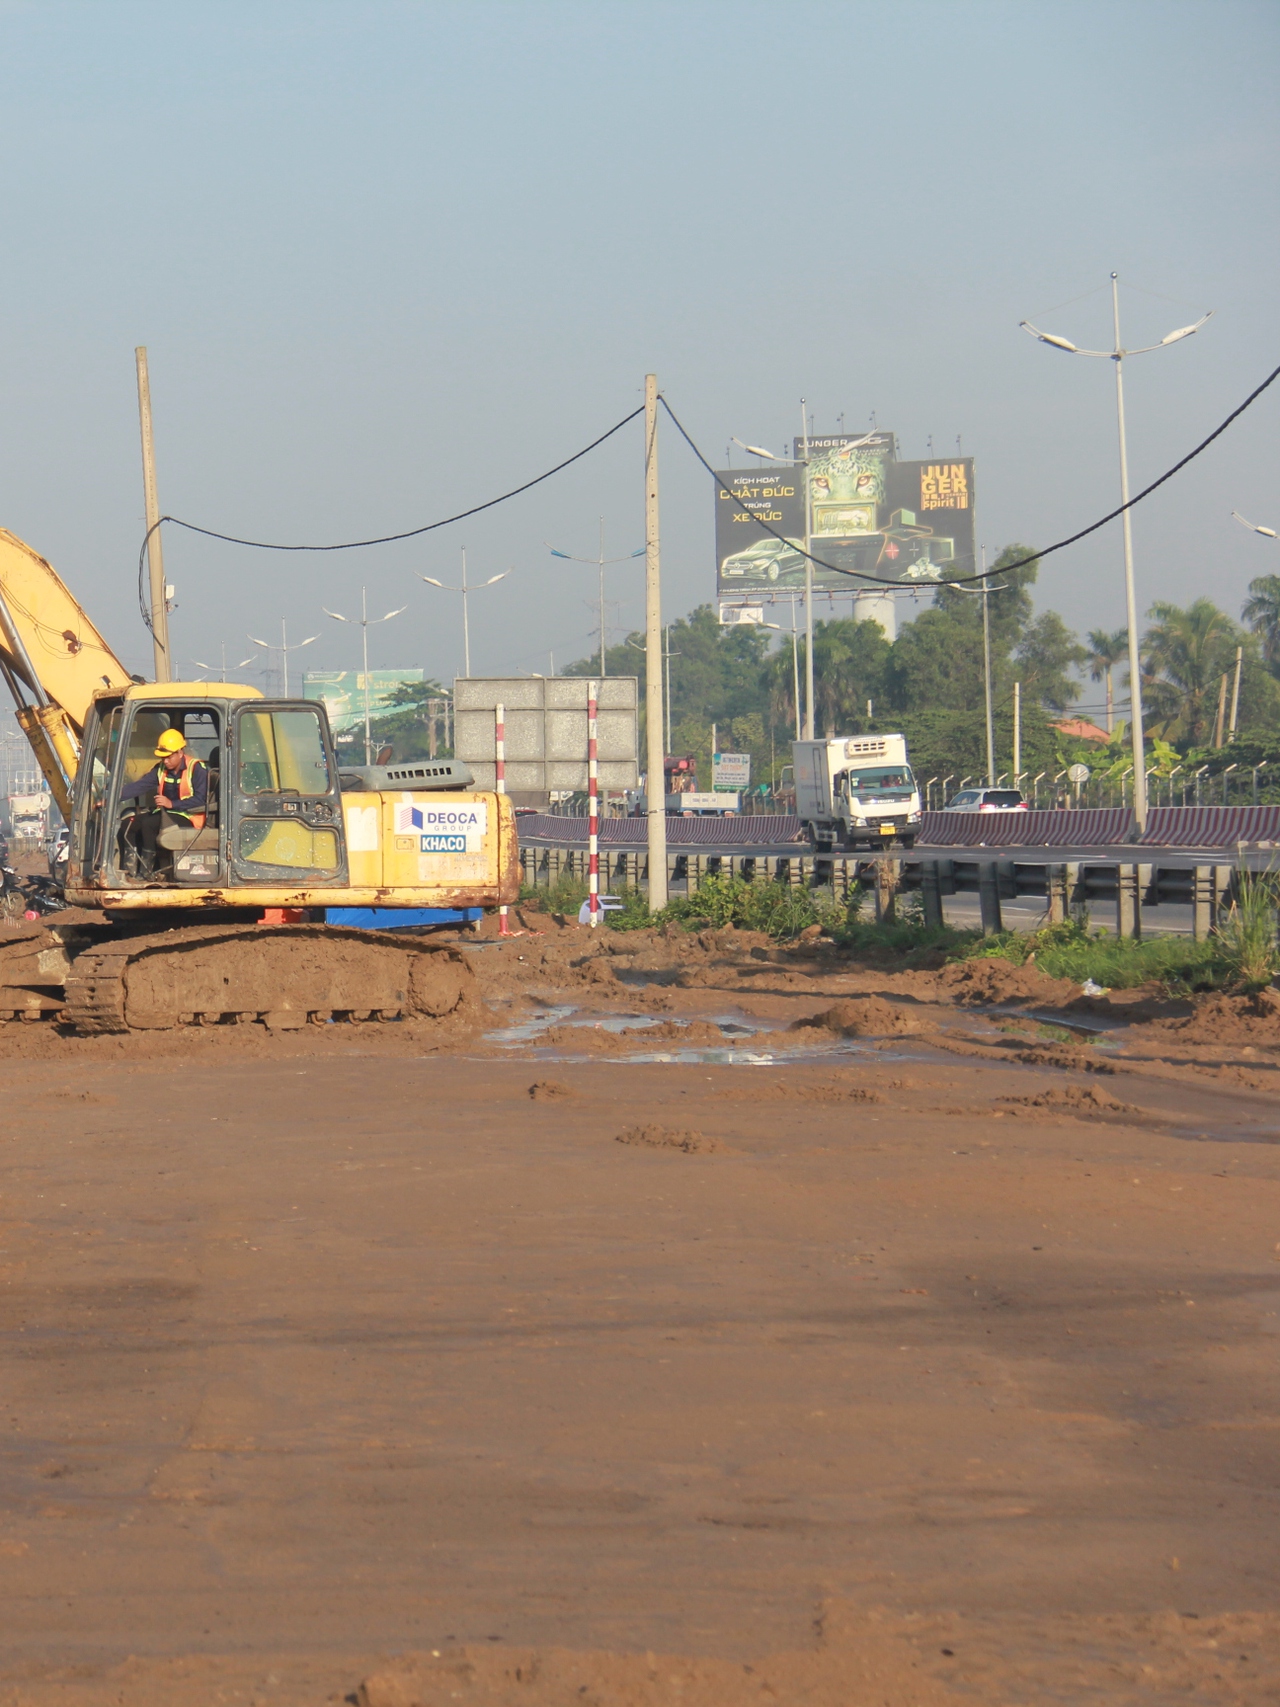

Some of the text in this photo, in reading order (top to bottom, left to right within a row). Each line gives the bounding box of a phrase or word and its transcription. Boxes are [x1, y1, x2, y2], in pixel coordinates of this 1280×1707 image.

[921, 464, 966, 480] JUN
[733, 476, 781, 485] KÍCH HOẠT
[921, 478, 968, 494] GER
[762, 484, 795, 498] ĐỨC
[733, 513, 750, 522] XE
[427, 812, 478, 824] DEOCA
[422, 836, 465, 851] KHACO
